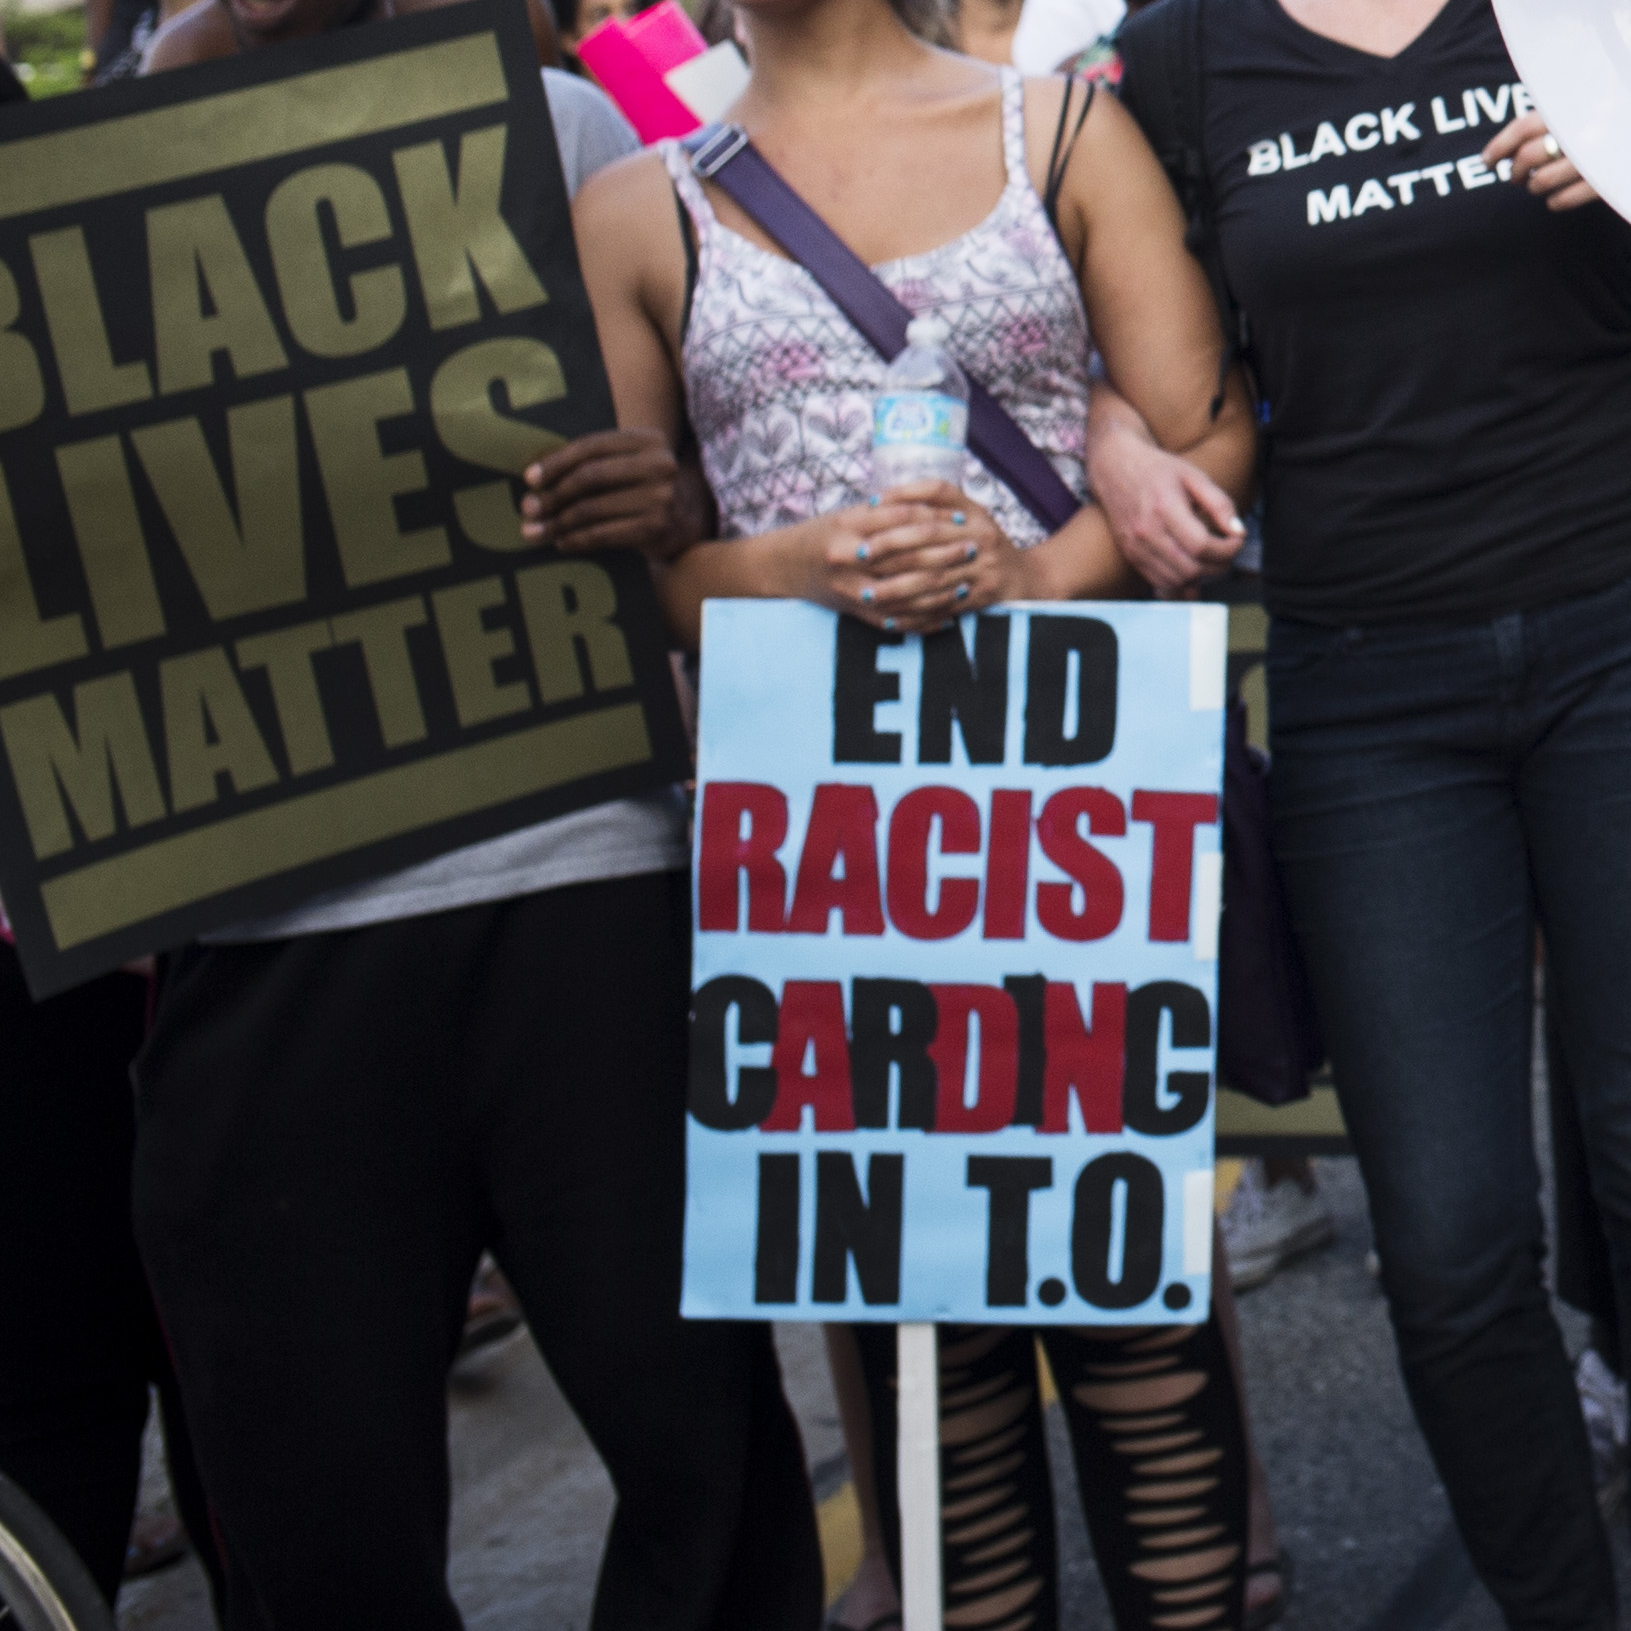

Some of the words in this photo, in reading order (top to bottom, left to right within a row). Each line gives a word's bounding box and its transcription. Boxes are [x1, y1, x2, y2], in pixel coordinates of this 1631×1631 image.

[1247, 102, 1423, 178] BLACK
[1430, 83, 1536, 136] LIVE
[1306, 153, 1514, 227] MATTE
[0, 560, 635, 861] MATTER
[832, 613, 1119, 769] END
[698, 781, 1219, 943] RACIST
[686, 971, 1212, 1138] CARDING
[754, 1150, 905, 1307] IN
[966, 1151, 1192, 1312] T.O.
